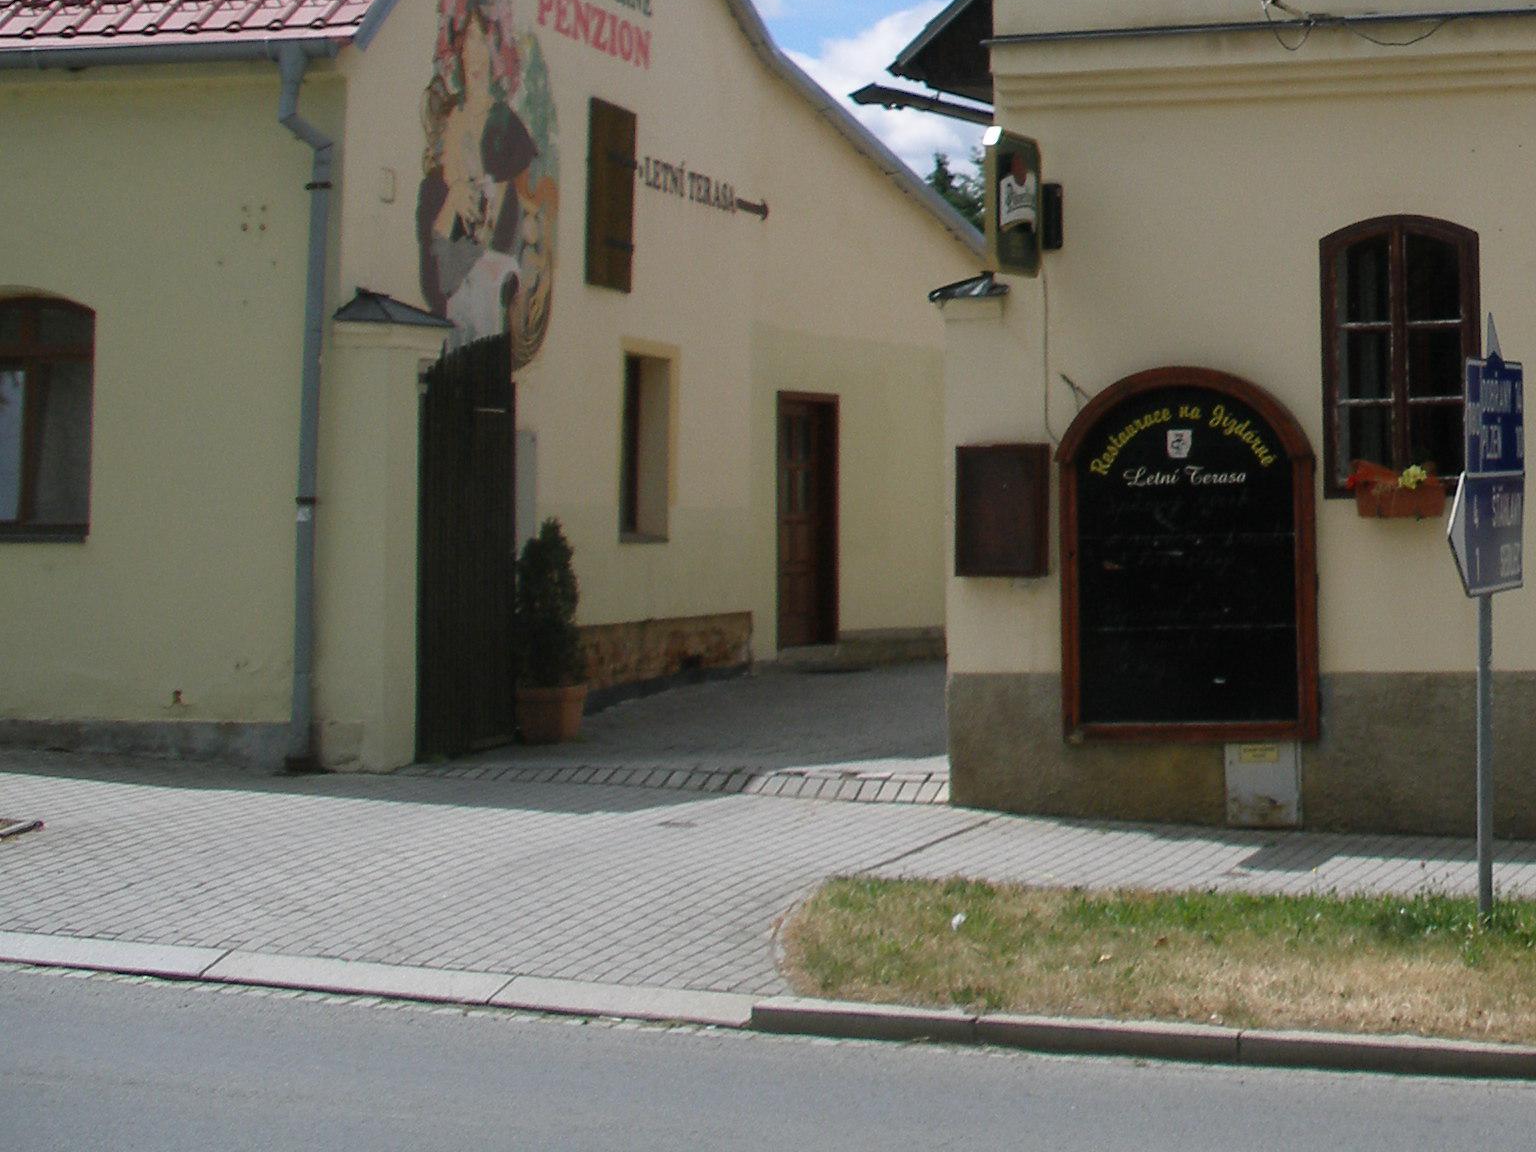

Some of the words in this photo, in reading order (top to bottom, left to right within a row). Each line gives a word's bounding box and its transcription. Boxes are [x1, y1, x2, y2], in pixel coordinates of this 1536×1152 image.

[644, 155, 685, 198] LETNÍ
[688, 170, 737, 215] TERASA
[1090, 407, 1172, 475] Restaurace
[1179, 403, 1201, 420] na
[1122, 466, 1181, 487] Letní
[1184, 465, 1247, 485] Terasa
